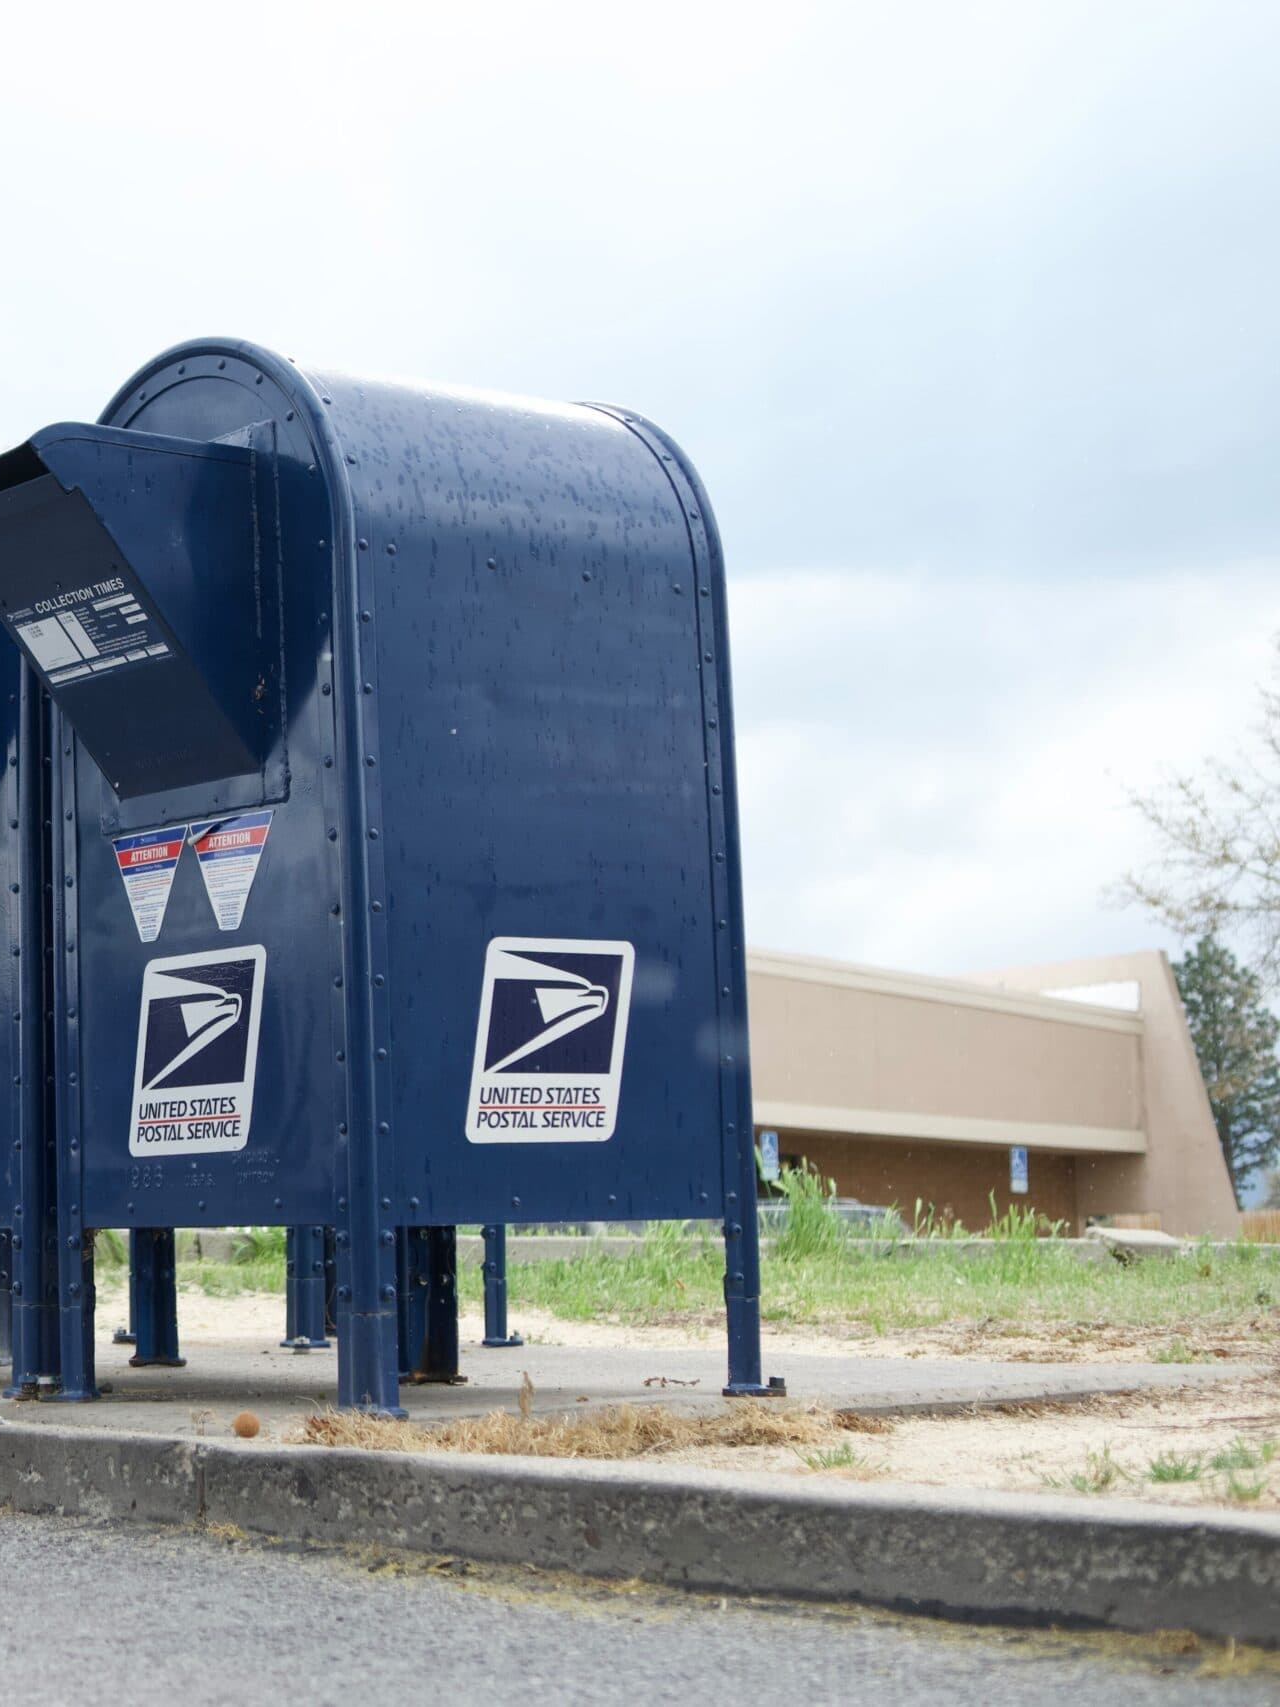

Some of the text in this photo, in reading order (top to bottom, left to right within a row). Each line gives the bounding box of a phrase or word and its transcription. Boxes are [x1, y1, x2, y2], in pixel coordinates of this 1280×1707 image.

[35, 586, 94, 614] COLLECTION
[94, 577, 125, 596] TIMES
[209, 831, 251, 849] ATTENTION
[131, 847, 168, 863] ATTENTION
[480, 1087, 601, 1105] UNITED STATES
[139, 1096, 236, 1121] UNITED STATES
[477, 1110, 607, 1129] POSTAL SERVICE
[137, 1119, 241, 1143] POSTAL SERVICE
